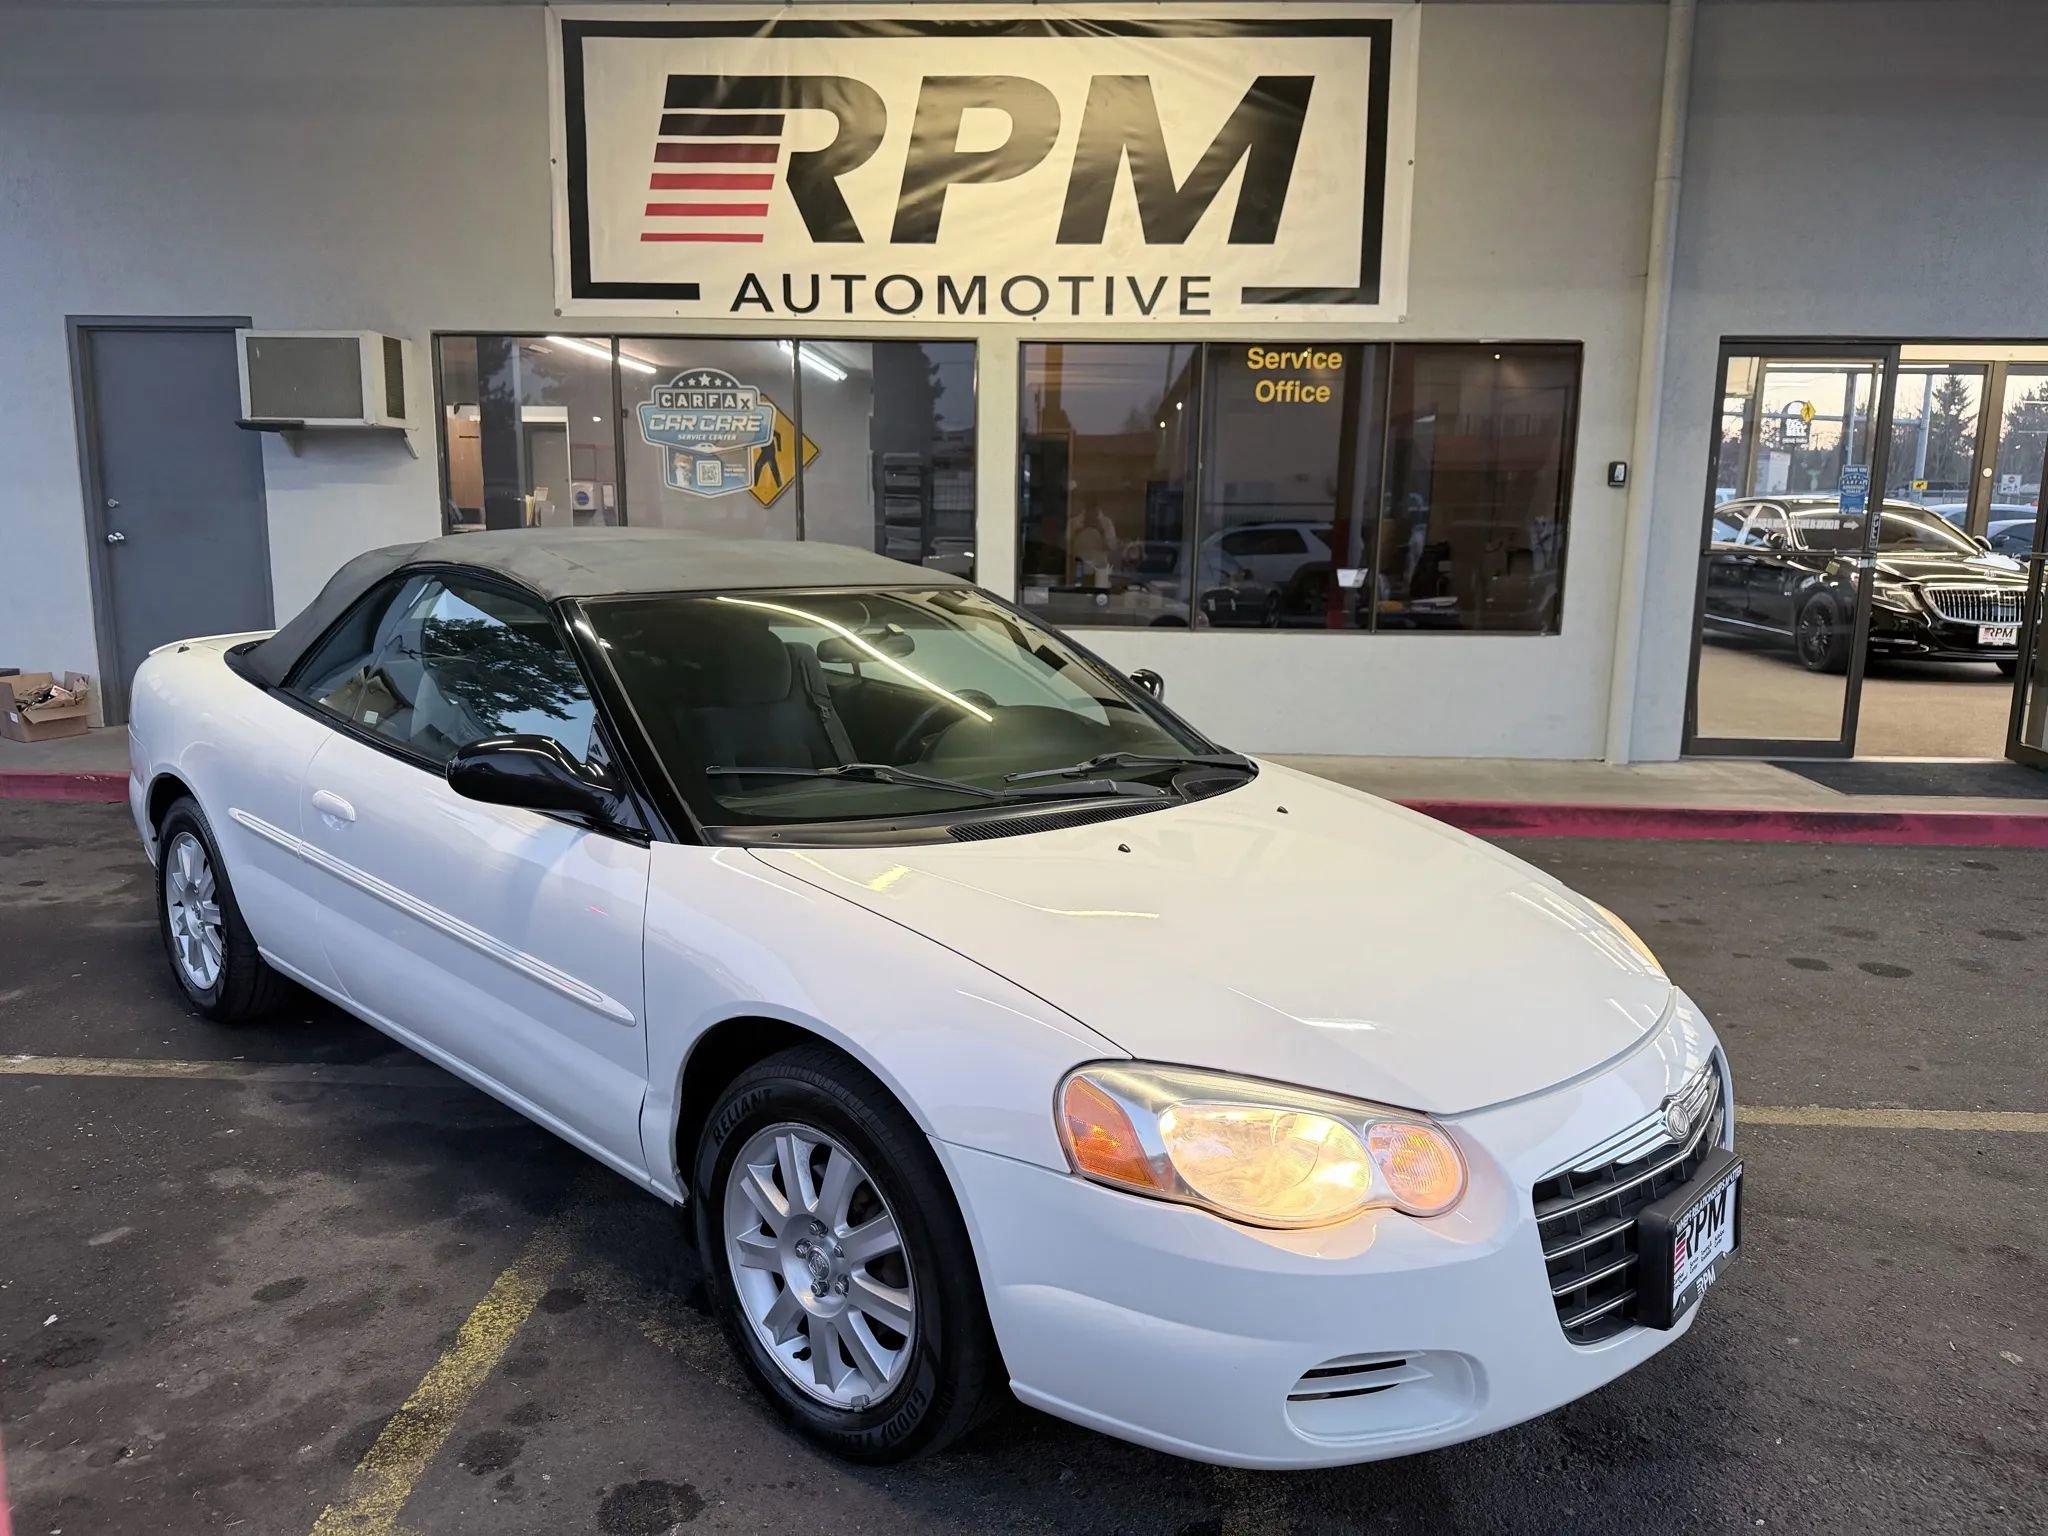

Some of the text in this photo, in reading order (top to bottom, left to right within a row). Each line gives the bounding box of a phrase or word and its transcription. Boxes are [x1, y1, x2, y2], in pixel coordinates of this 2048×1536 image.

[640, 74, 1315, 245] RPM
[730, 272, 1213, 317] AUTOMOTIVE
[1247, 347, 1343, 370] Service
[660, 393, 752, 410] CARFAX
[1255, 380, 1331, 404] Office
[649, 414, 761, 432] CAR CARE
[1984, 627, 2013, 638] RPM
[713, 1088, 772, 1146] RELIANT
[1675, 1189, 1728, 1275] RPM
[1696, 1264, 1716, 1299] RPM
